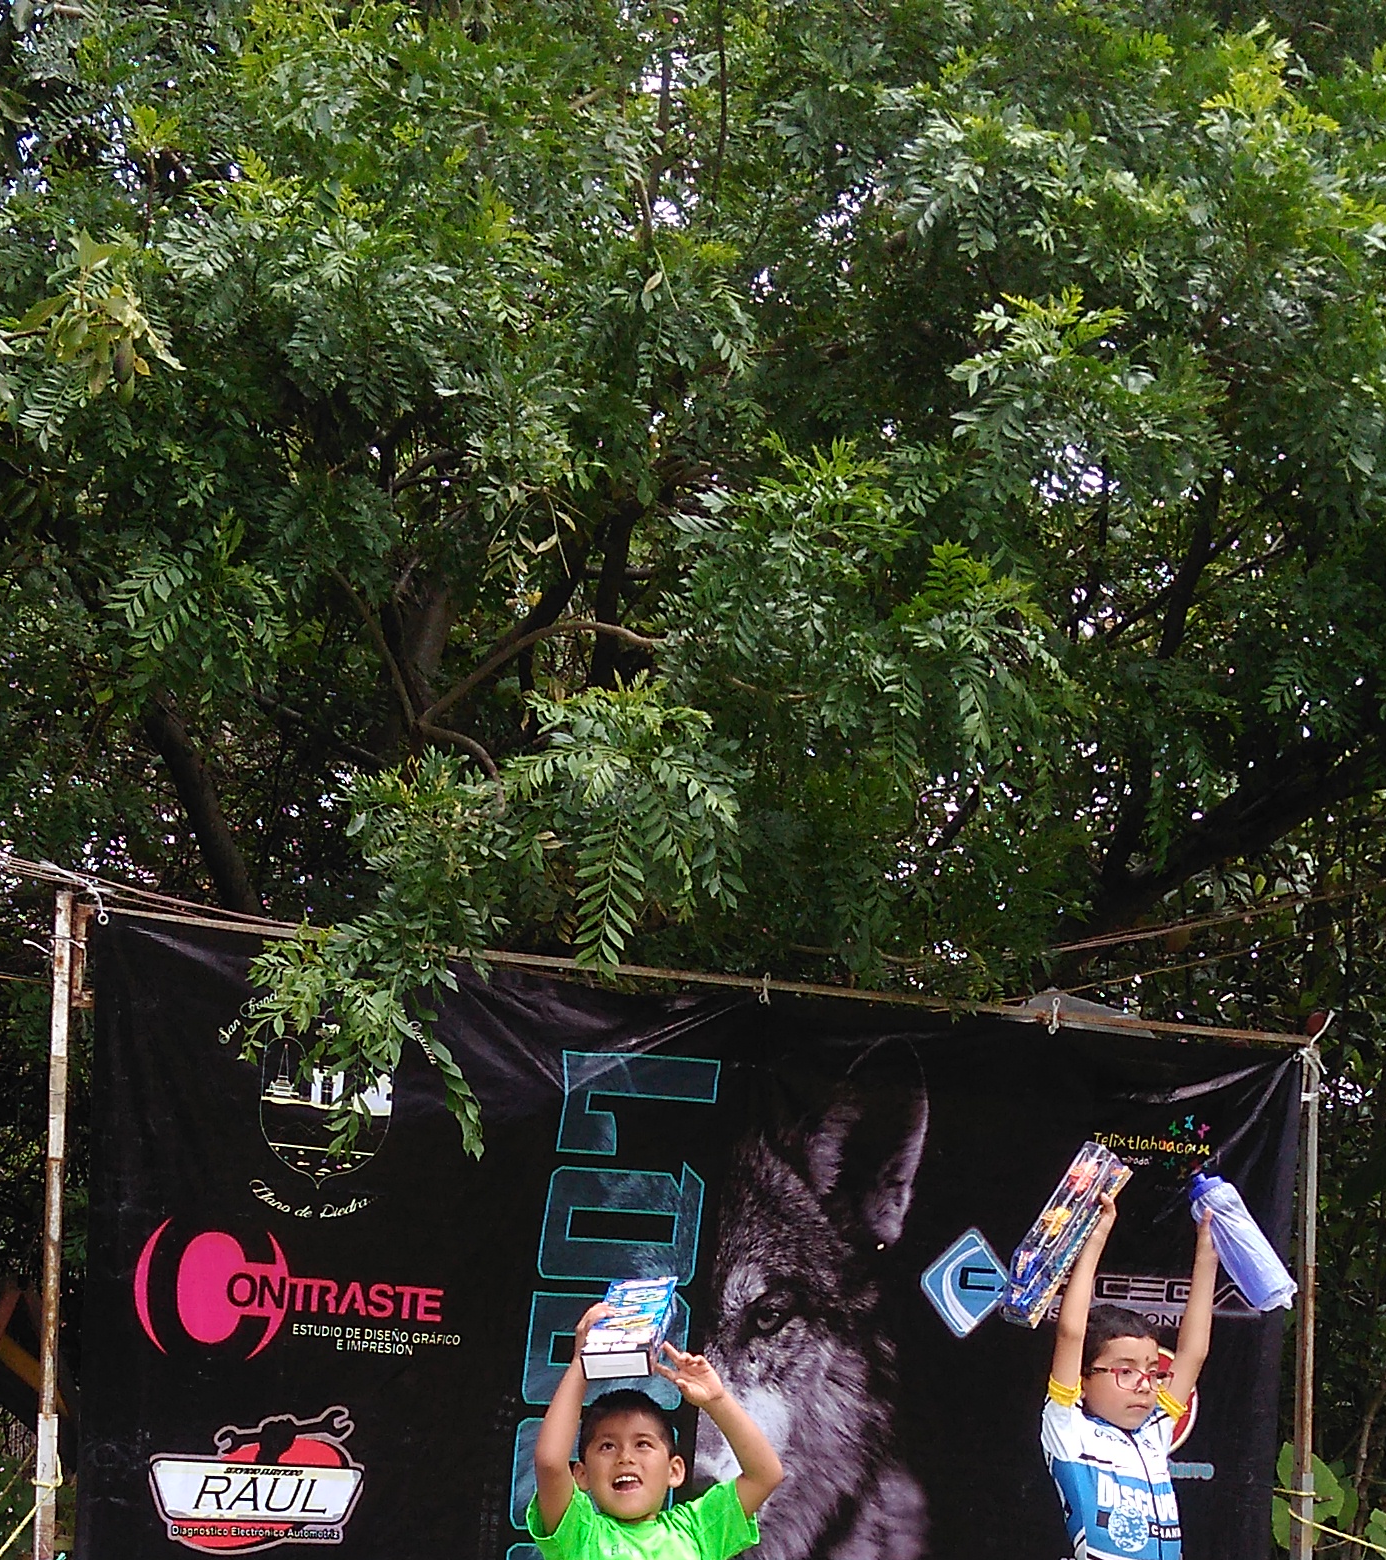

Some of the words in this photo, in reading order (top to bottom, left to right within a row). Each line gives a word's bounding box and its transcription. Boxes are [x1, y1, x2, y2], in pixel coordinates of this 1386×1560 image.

[218, 1019, 241, 1044] San
[292, 1323, 343, 1338] ESTUDIO
[345, 1327, 361, 1339] DE
[364, 1327, 409, 1343] DISEÑO
[336, 1339, 344, 1351] E
[346, 1340, 413, 1356] IMPRESION
[192, 1474, 328, 1515] RAUL
[287, 1527, 341, 1540] Automotriz
